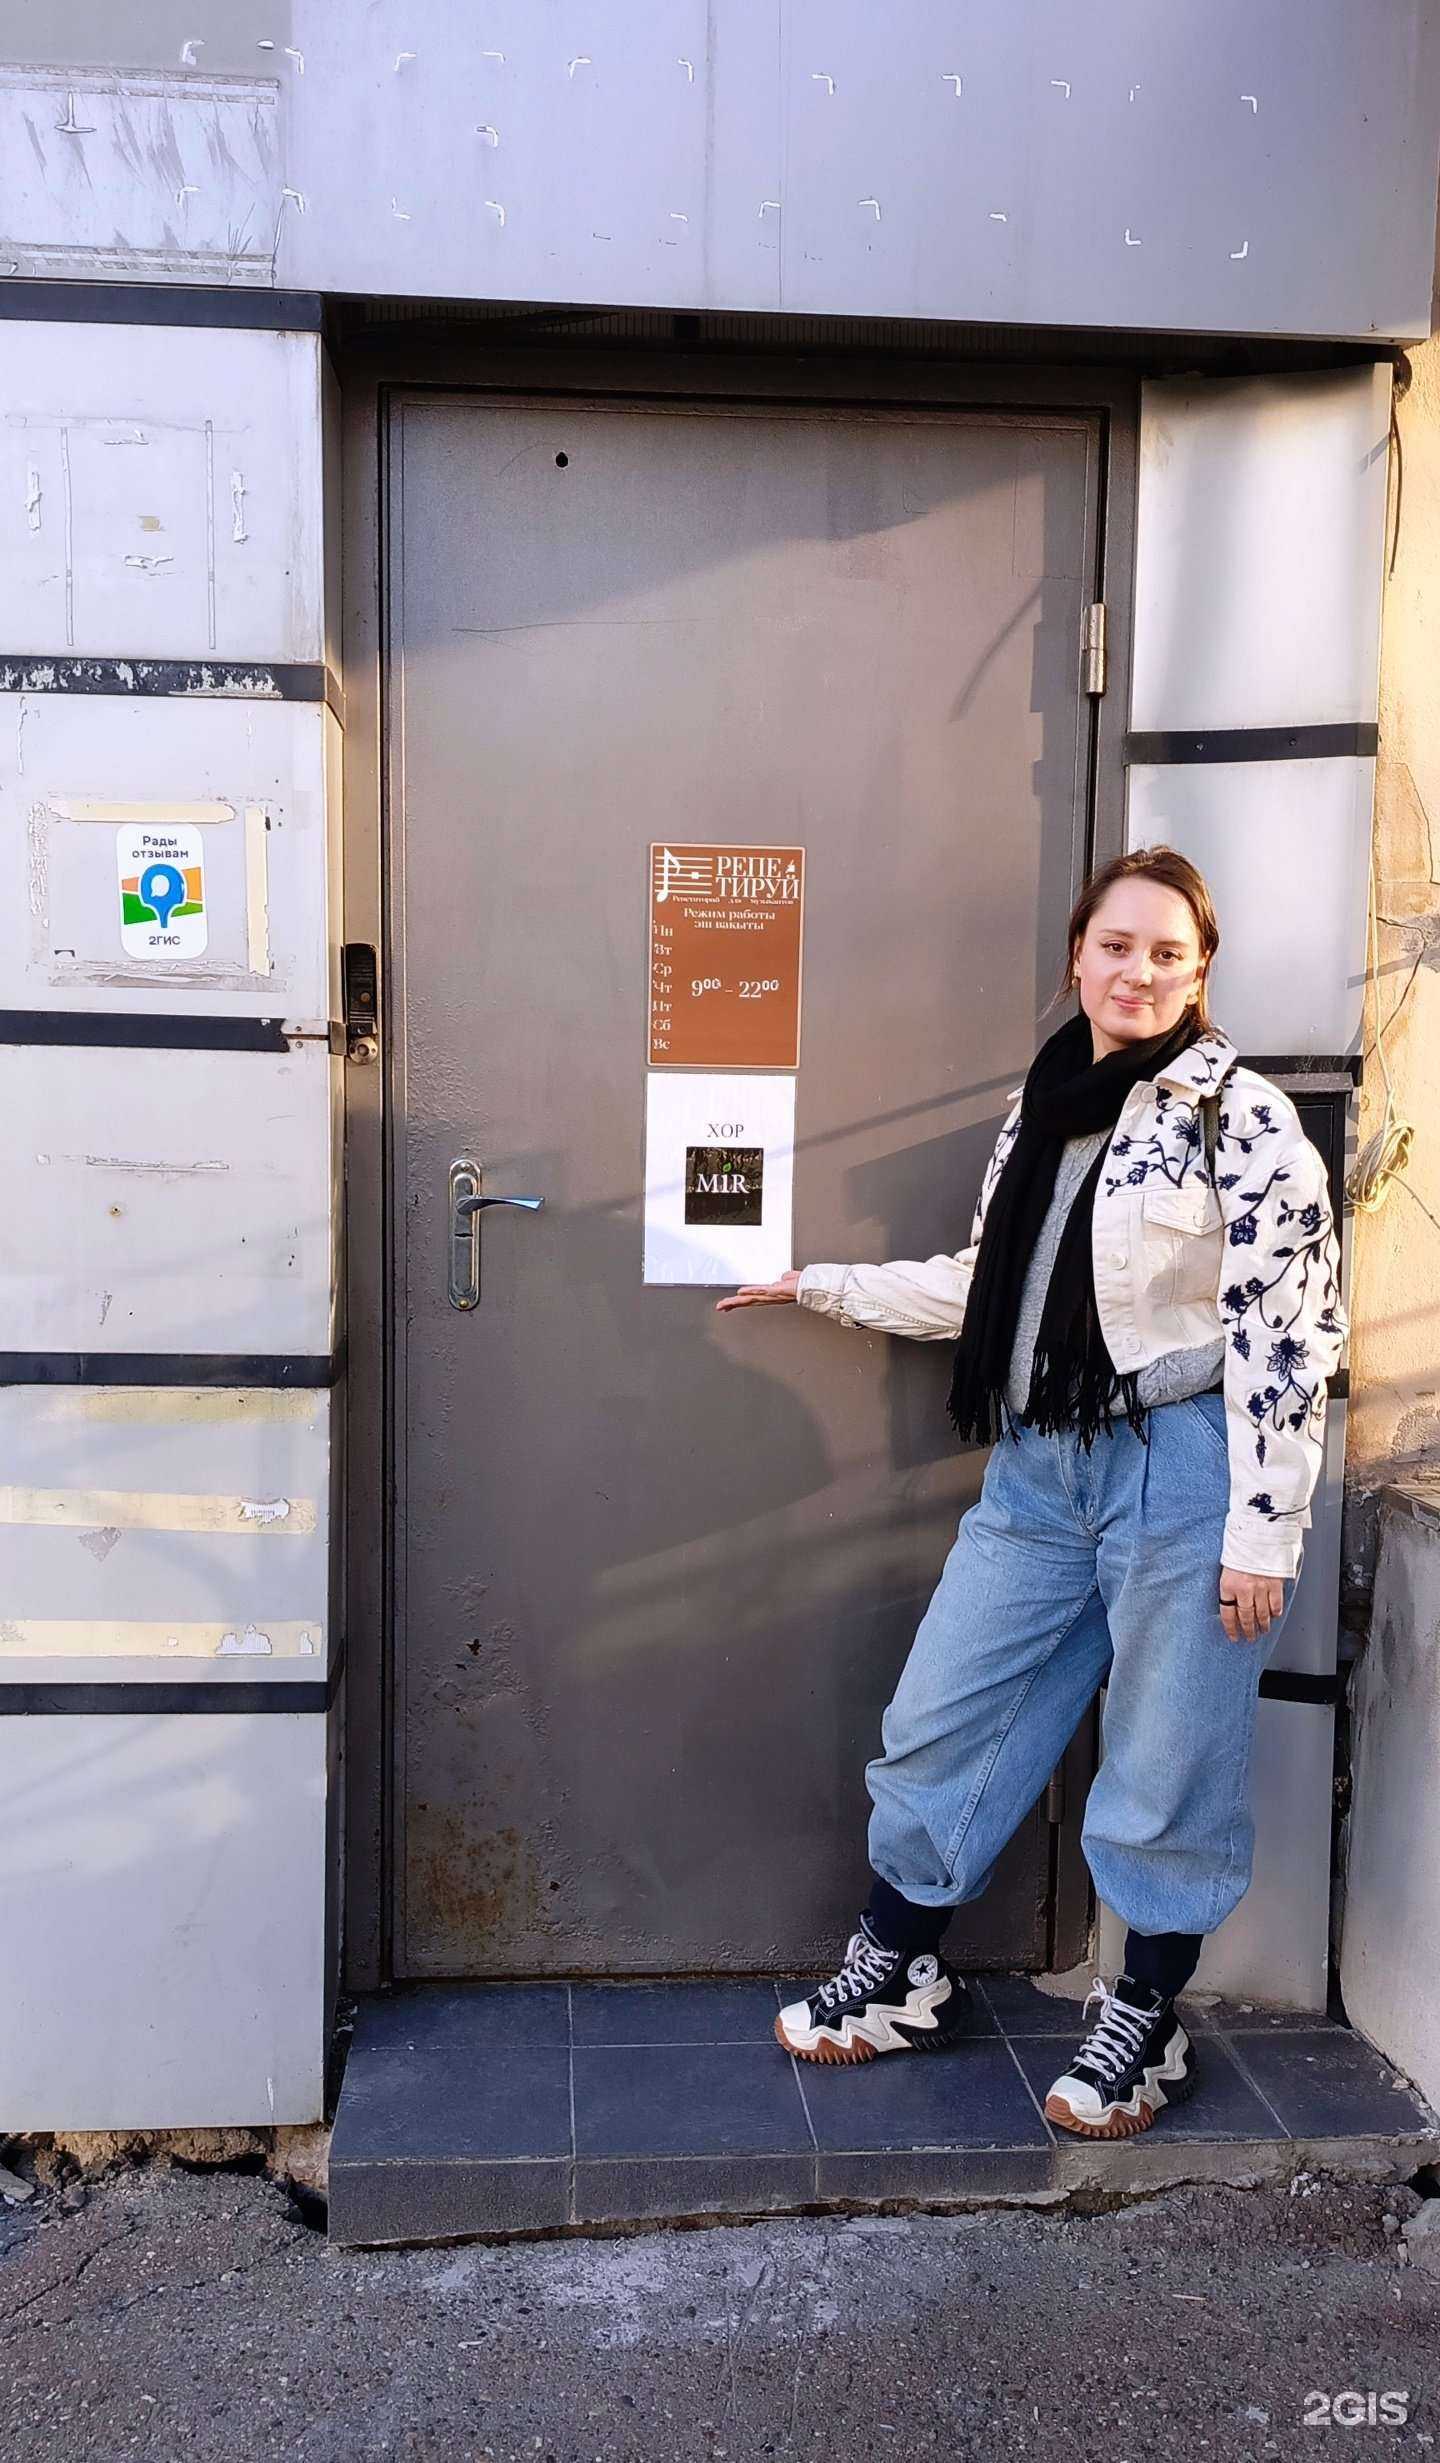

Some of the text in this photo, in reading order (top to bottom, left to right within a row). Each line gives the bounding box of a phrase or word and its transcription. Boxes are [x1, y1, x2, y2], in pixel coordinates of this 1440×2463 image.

[142, 835, 178, 848] Рады
[132, 849, 189, 859] отзывам
[716, 856, 782, 878] РЕПЕ
[716, 874, 799, 899] ТИРУЙ
[684, 908, 776, 922] Режим работы
[716, 921, 764, 930] вакыты
[148, 936, 181, 946] 2ГИС
[654, 943, 673, 956] Вт
[653, 962, 672, 977] Ср
[653, 980, 672, 993] Чт
[653, 1000, 672, 1012] Пт
[653, 1018, 671, 1031] Сб
[653, 1038, 671, 1050] Вс
[706, 1123, 745, 1138] ХОР
